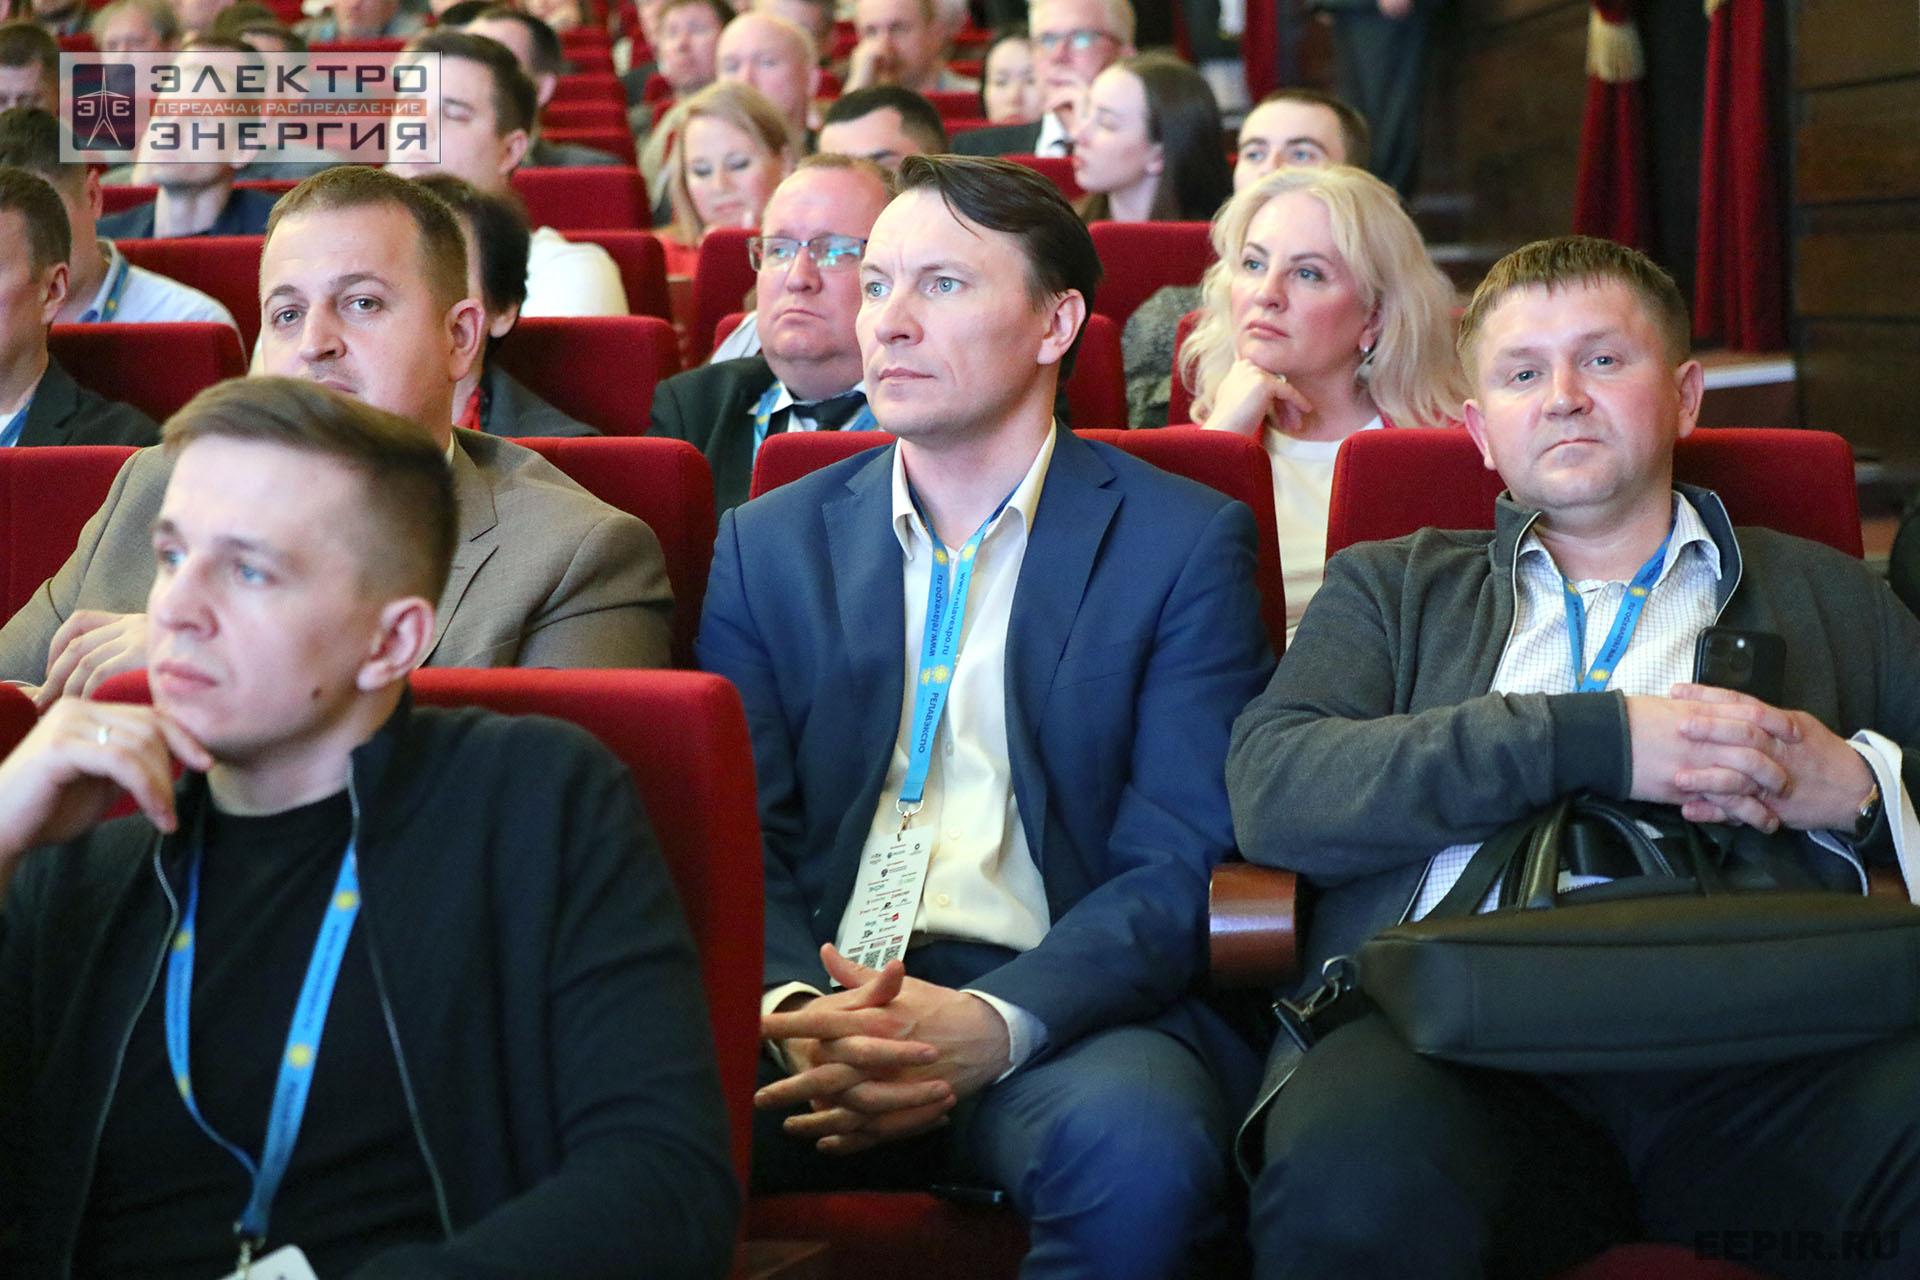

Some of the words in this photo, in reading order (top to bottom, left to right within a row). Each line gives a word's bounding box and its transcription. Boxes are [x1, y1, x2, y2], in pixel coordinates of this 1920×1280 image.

[928, 574, 944, 657] www.relavexpo.ru
[942, 572, 966, 655] www.relavexpo.ru
[918, 691, 939, 753] РЕЛАВЭКСПО
